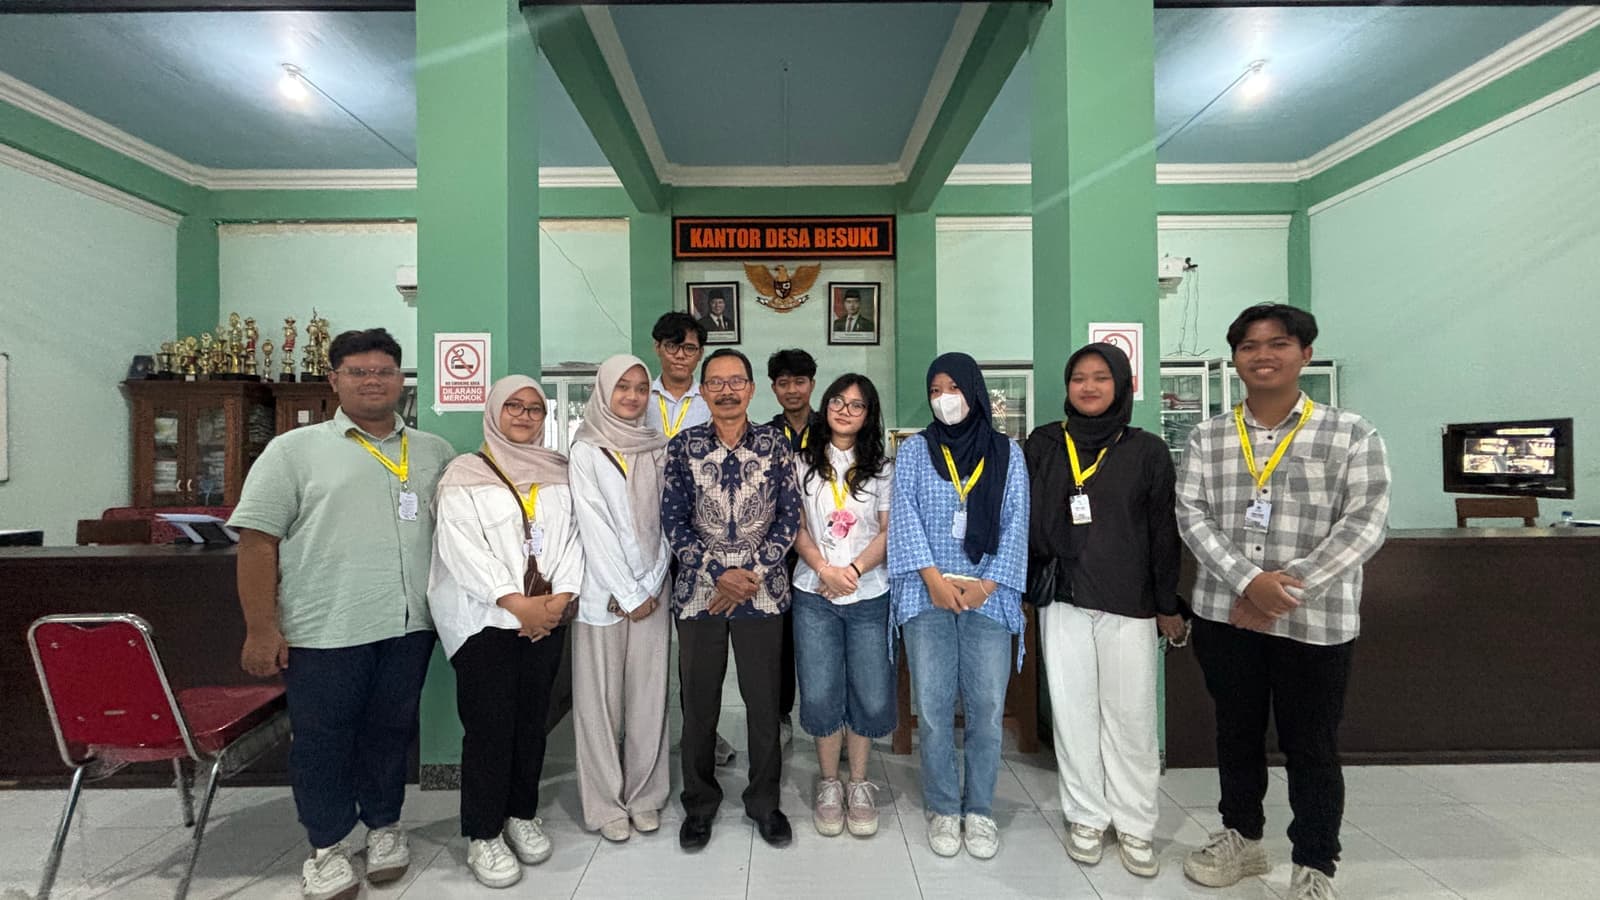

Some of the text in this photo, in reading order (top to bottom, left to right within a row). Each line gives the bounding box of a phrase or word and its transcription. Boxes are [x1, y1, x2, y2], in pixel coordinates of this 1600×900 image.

[690, 226, 879, 249] KANTOR DESA BESUKI
